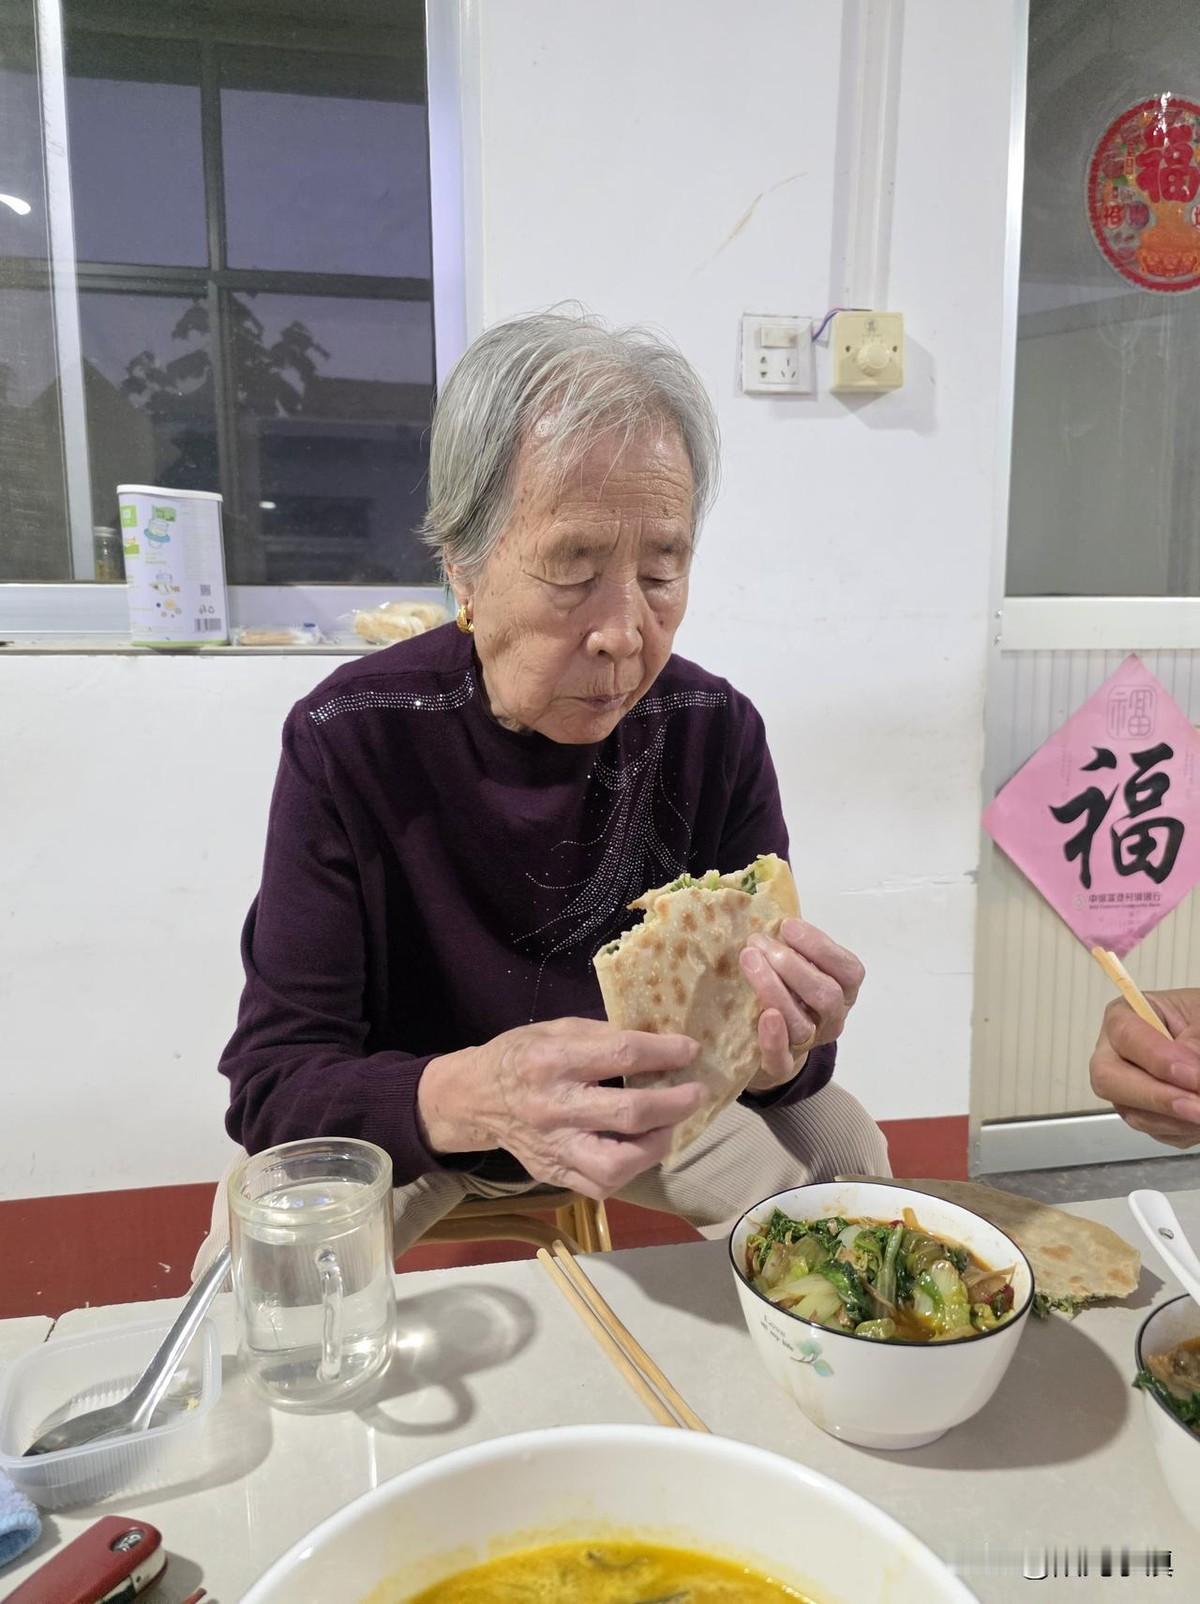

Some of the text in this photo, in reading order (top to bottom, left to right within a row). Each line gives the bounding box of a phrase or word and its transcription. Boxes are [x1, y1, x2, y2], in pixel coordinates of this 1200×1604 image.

[1136, 124, 1199, 203] 福
[1110, 690, 1153, 736] 福
[1048, 742, 1184, 890] 福
